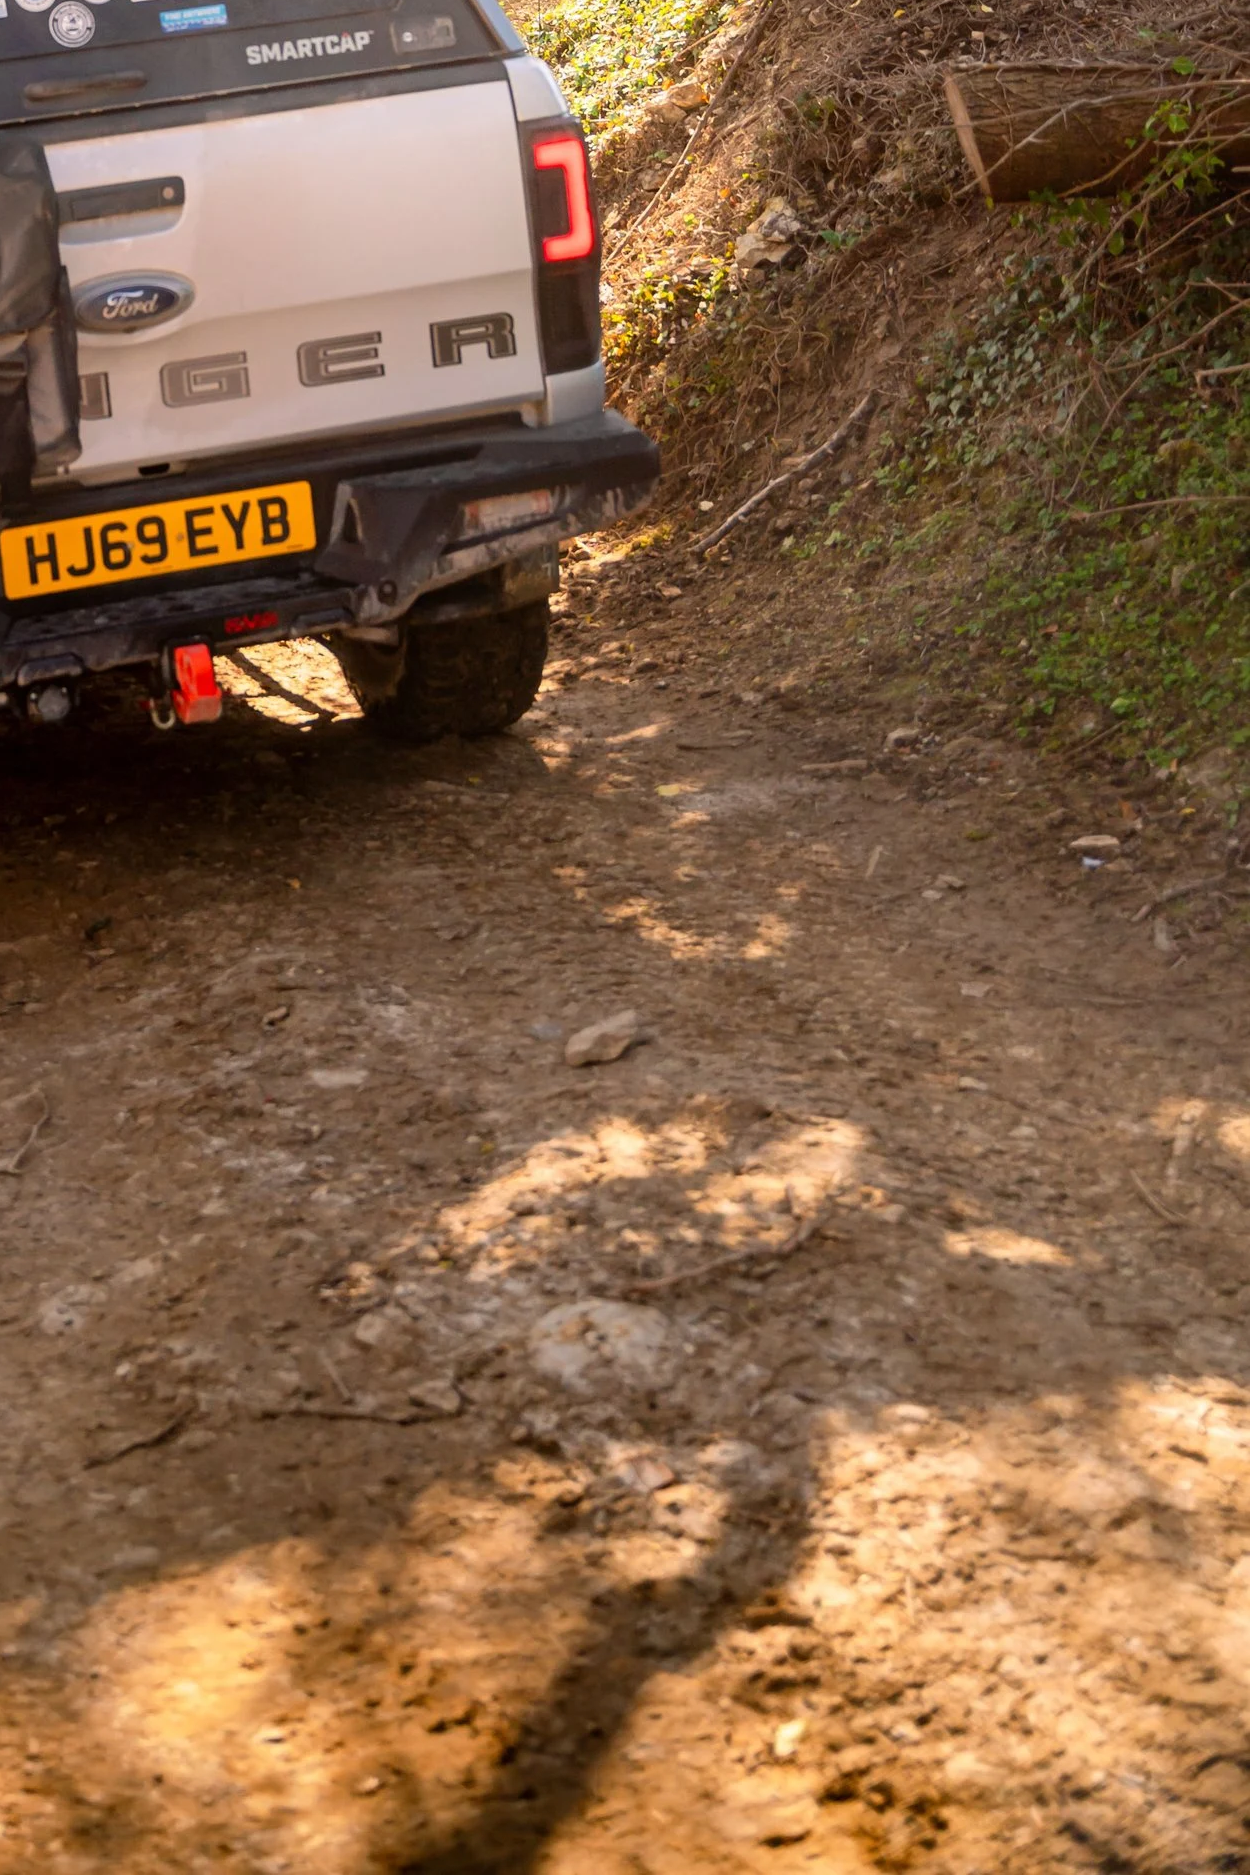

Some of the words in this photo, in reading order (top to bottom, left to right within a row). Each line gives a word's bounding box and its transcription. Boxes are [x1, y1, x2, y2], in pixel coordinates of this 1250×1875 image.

[102, 290, 159, 319] Ford
[25, 516, 169, 585] HJ69
[184, 496, 291, 557] EYB
